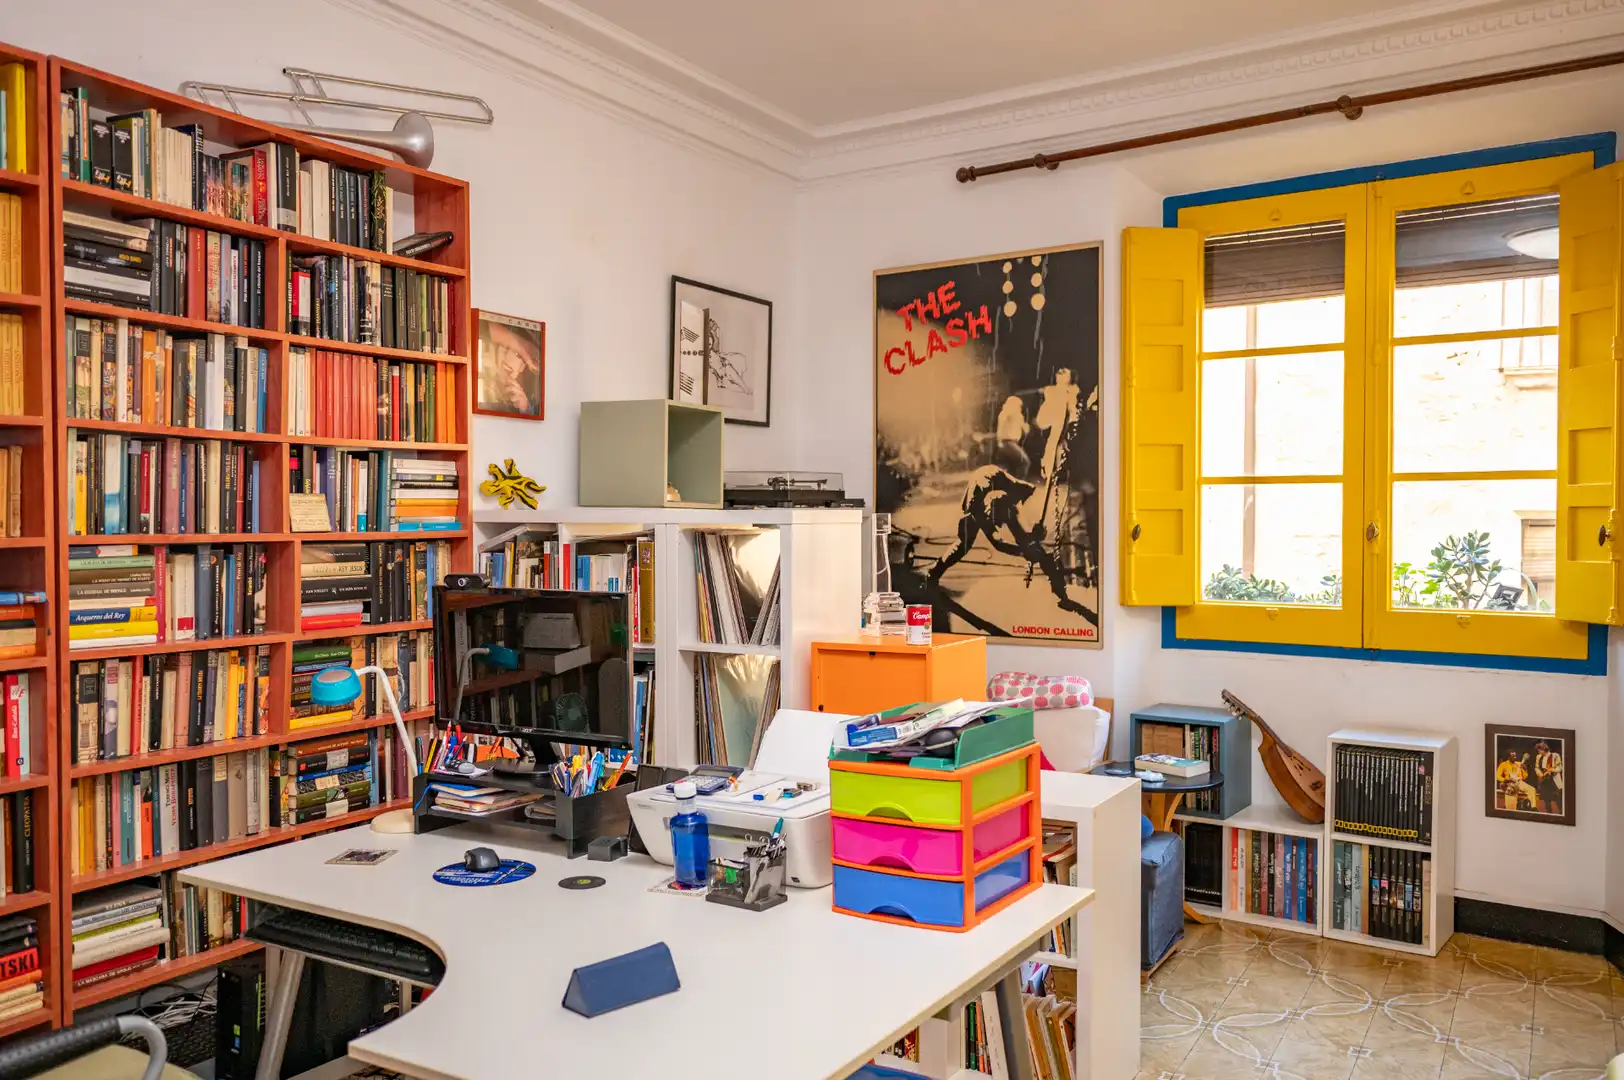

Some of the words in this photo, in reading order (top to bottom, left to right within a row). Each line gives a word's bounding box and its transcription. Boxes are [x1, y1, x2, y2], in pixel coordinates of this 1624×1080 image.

[896, 280, 961, 332] THE
[884, 304, 992, 375] CLASH
[75, 613, 103, 622] Arqueros
[103, 612, 112, 620] del
[113, 612, 126, 620] Rey
[912, 611, 930, 621] Camp
[1012, 625, 1050, 635] LONDON
[1053, 627, 1094, 637] CALLING
